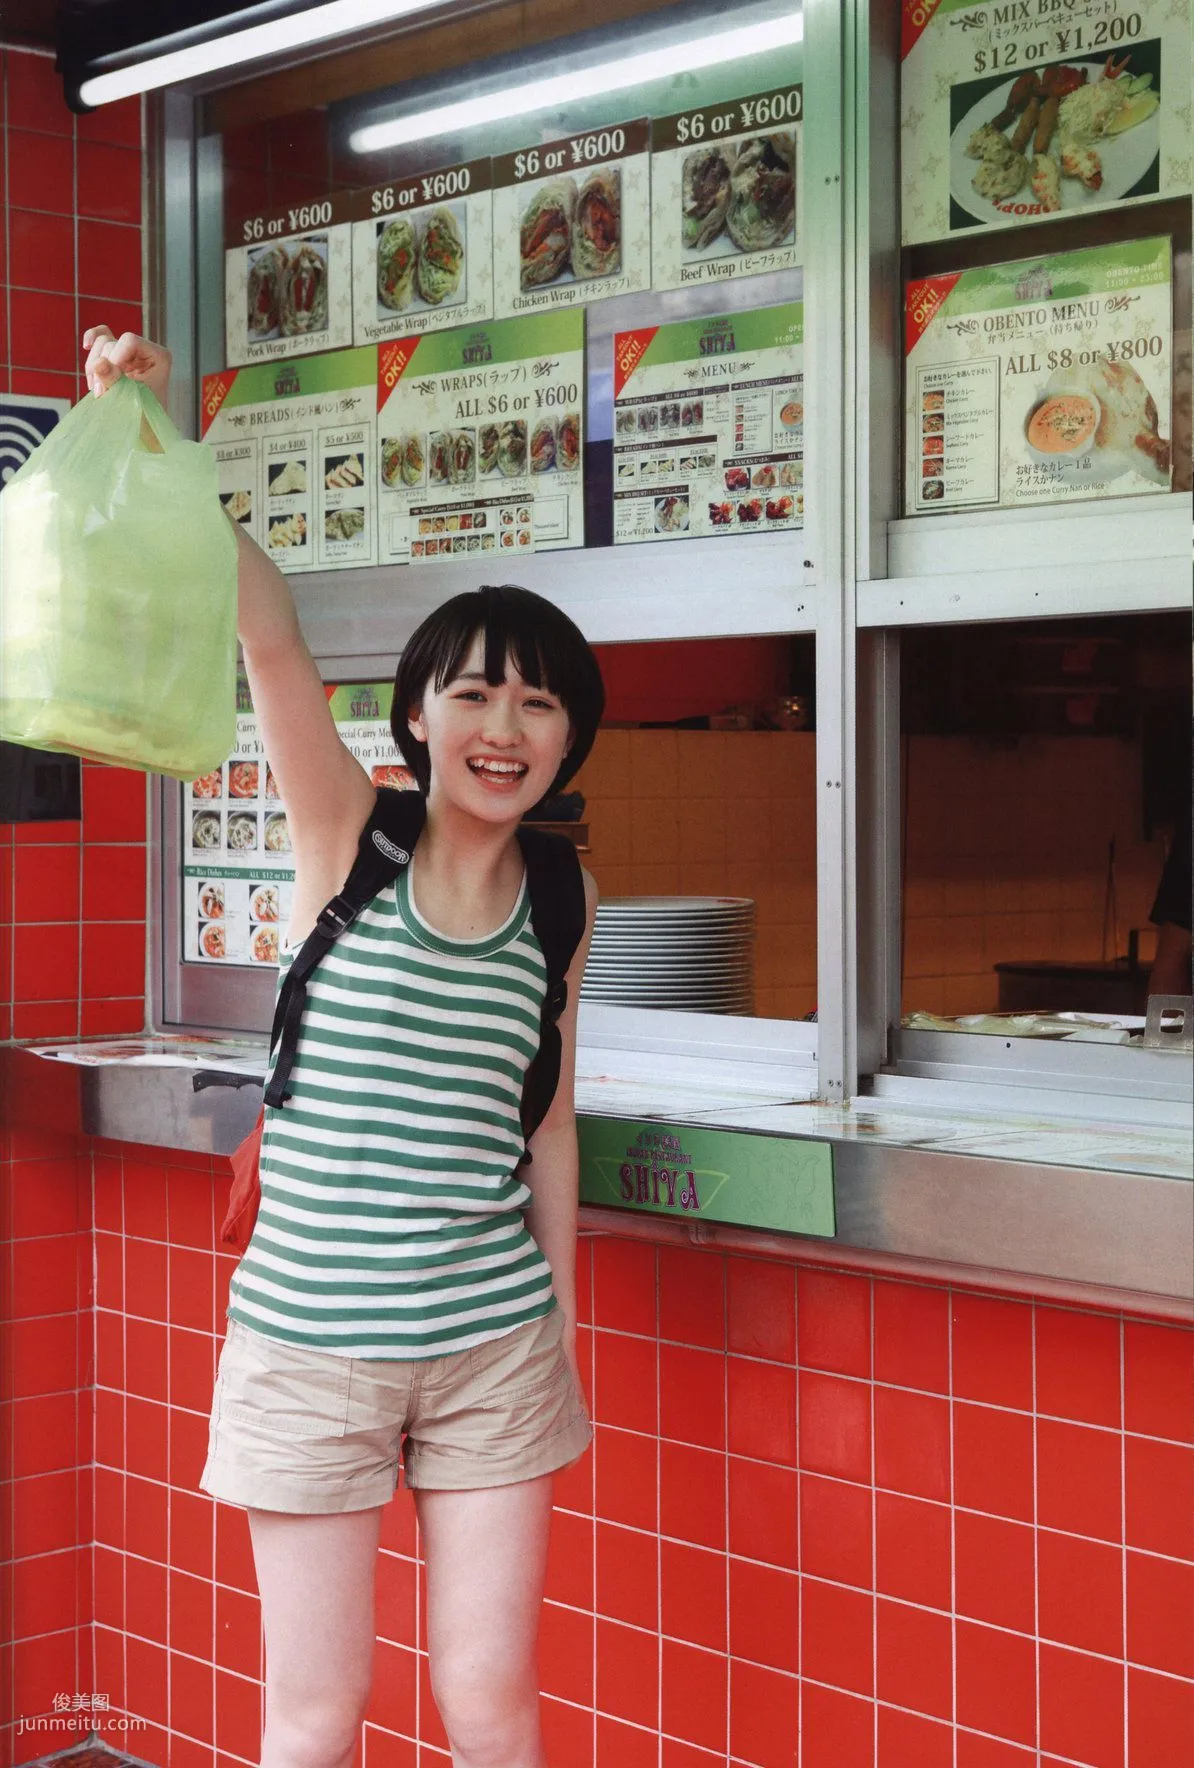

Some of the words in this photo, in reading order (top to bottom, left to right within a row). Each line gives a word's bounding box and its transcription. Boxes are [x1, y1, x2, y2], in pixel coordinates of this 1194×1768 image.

[994, 1, 1030, 25] MIX
[974, 43, 1017, 74] $12
[1025, 40, 1049, 60] or
[1056, 13, 1142, 53] ¥1,200
[677, 114, 704, 143] $6
[711, 112, 734, 133] or
[740, 90, 801, 127] ¥600
[514, 154, 539, 178] $6
[545, 149, 566, 170] or
[570, 129, 625, 164] ¥600
[372, 190, 395, 214] $6
[399, 187, 417, 205] or
[421, 168, 471, 200] ¥600
[243, 218, 264, 241] $6
[268, 219, 284, 235] or
[289, 201, 332, 232] ¥600
[681, 267, 703, 282] Beef
[707, 262, 735, 280] Wrap
[512, 293, 549, 310] Chicken
[550, 288, 576, 304] Wrap
[913, 288, 938, 323] OK!!
[364, 321, 403, 338] Vegetable
[404, 315, 428, 332] Wrap
[984, 308, 1047, 333] OBENTO
[1051, 300, 1100, 323] MENU
[247, 345, 264, 358] Pork
[266, 343, 287, 355] Wrap
[620, 339, 641, 371] OK!!
[1005, 353, 1041, 376] ALL
[1047, 347, 1073, 371] $8
[1079, 347, 1099, 365] or
[1106, 335, 1163, 362] ¥800
[385, 350, 407, 387] OK!!
[701, 361, 737, 378] MENU
[207, 383, 227, 416] OK!!
[455, 398, 483, 419] ALL
[488, 393, 509, 415] $6
[513, 395, 530, 411] or
[534, 383, 578, 408] ¥600
[1015, 489, 1038, 497] Choose
[1091, 482, 1105, 490] Rice
[1016, 473, 1065, 487] ライスかナン
[237, 720, 256, 734] Curry
[358, 728, 376, 741] Curry
[242, 743, 251, 753] or
[362, 749, 372, 757] or
[374, 832, 406, 862] OUTDOOR
